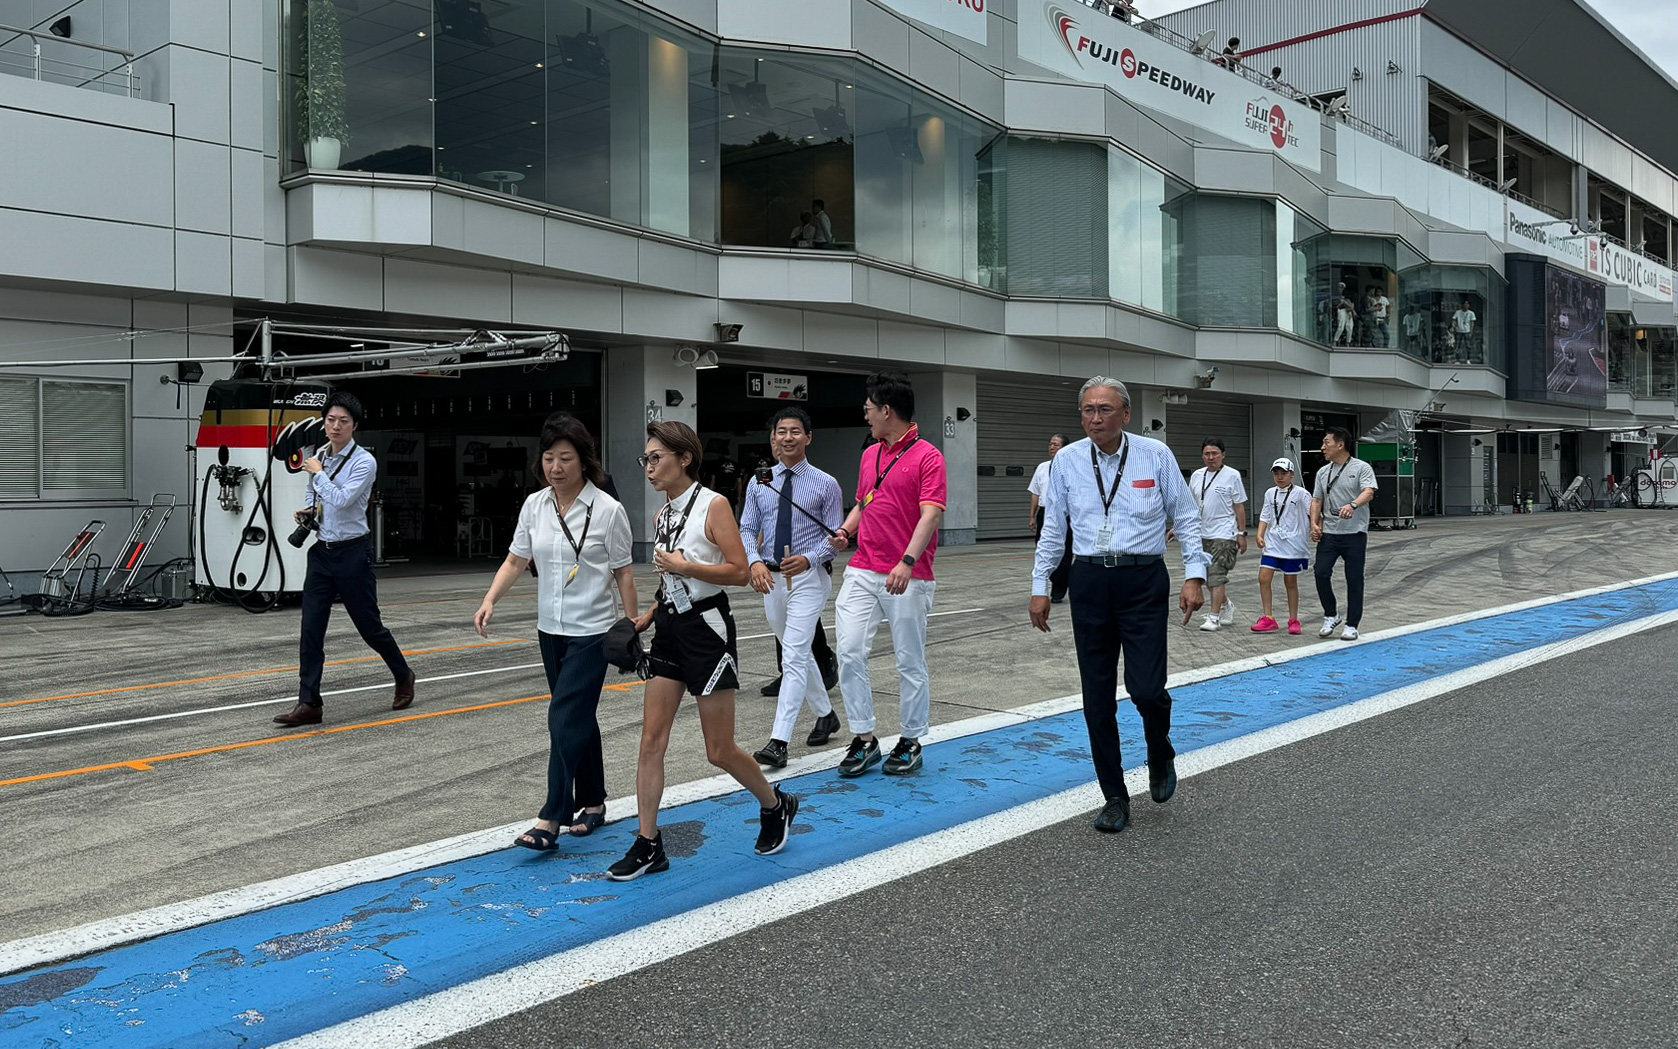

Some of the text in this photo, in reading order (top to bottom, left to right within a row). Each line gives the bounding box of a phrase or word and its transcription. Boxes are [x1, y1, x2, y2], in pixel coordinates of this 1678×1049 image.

[1077, 36, 1216, 105] FUJI SPEEDWAY
[1246, 102, 1269, 123] FUJI
[1245, 117, 1300, 148] SUPER TEC
[1509, 211, 1583, 260] Panasonic AUTOMOTIVE
[1600, 247, 1657, 289] TS CUBIC CARD
[751, 378, 761, 392] 15
[647, 409, 662, 423] 34
[945, 422, 954, 436] 33
[1640, 479, 1677, 487] docomo
